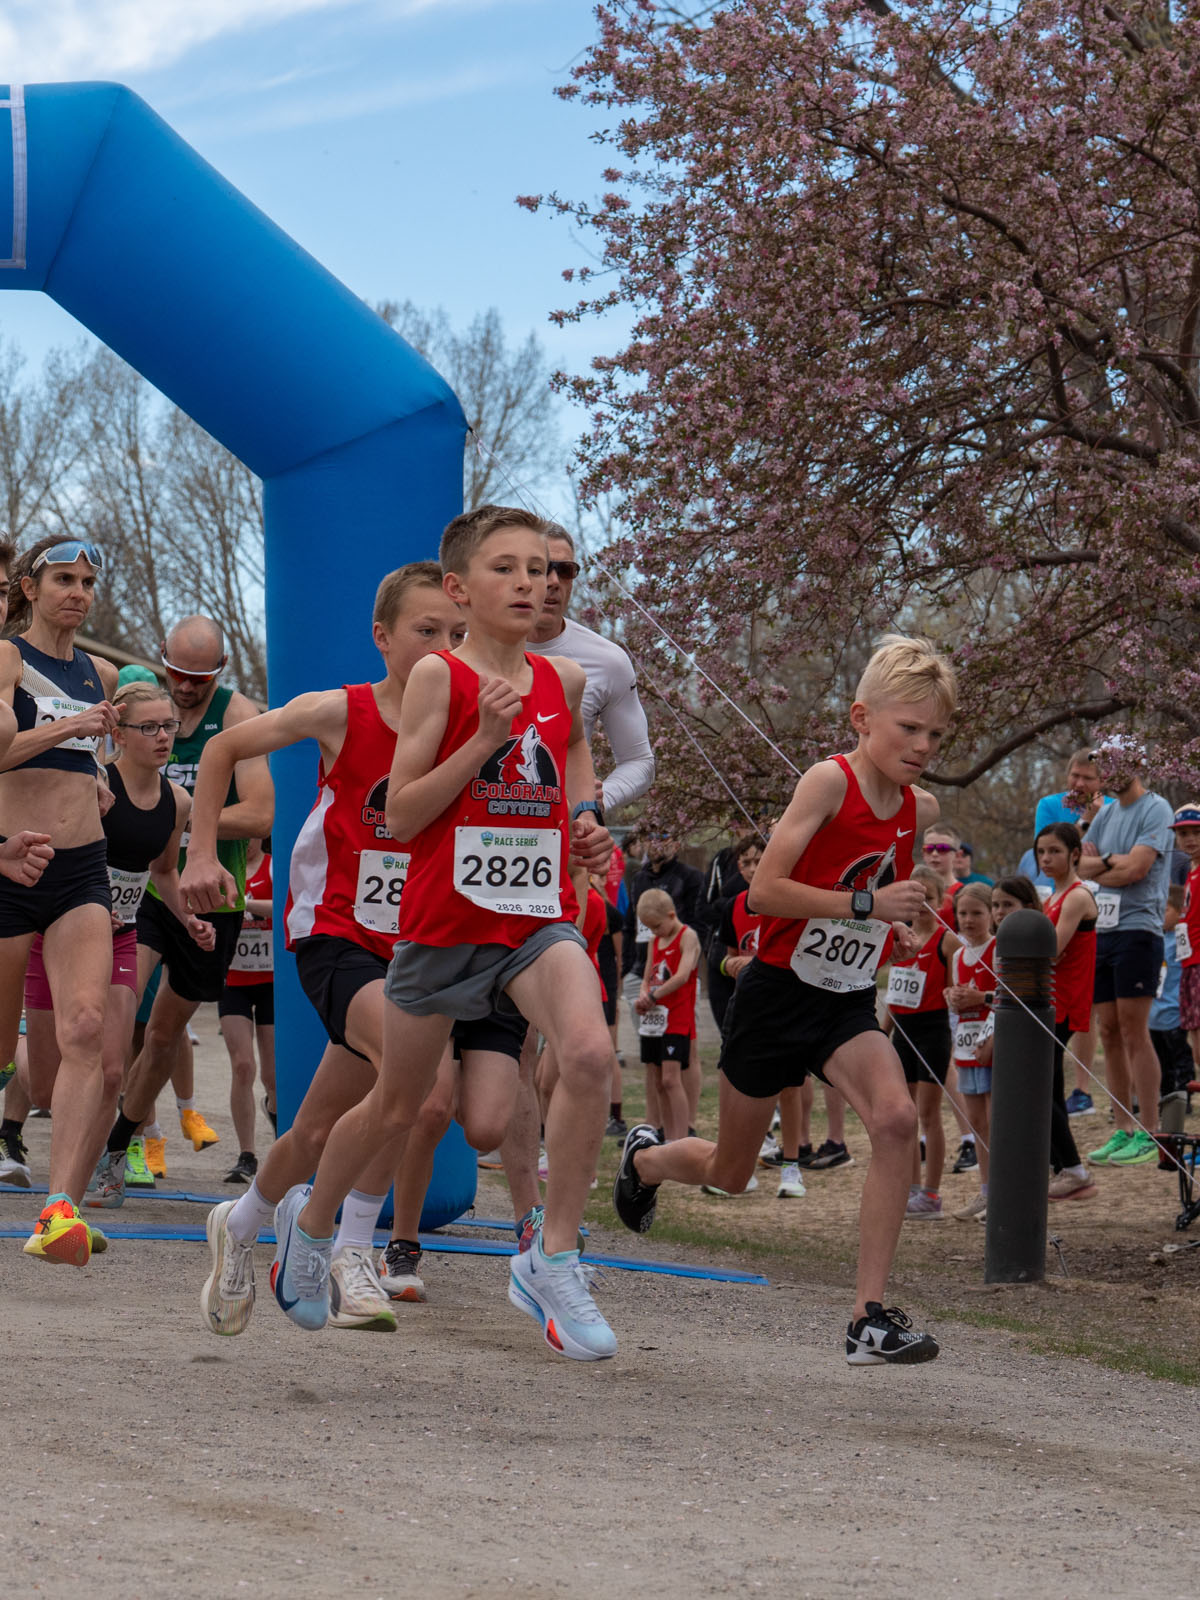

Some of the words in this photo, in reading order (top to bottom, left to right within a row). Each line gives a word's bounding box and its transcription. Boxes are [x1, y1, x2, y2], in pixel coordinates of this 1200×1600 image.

[471, 779, 561, 804] COLORADO
[488, 800, 551, 817] COYOTES
[494, 837, 514, 846] RACE
[515, 837, 538, 847] SERIES
[395, 861, 409, 870] RAC
[461, 854, 552, 888] 2826
[111, 886, 142, 905] 099
[363, 875, 406, 906] 28
[496, 904, 523, 912] 2826
[528, 904, 555, 914] 2826
[840, 919, 854, 930] RACE
[854, 921, 873, 934] SERIES
[237, 942, 269, 957] 041
[803, 928, 877, 970] 2807
[822, 977, 843, 990] 2807
